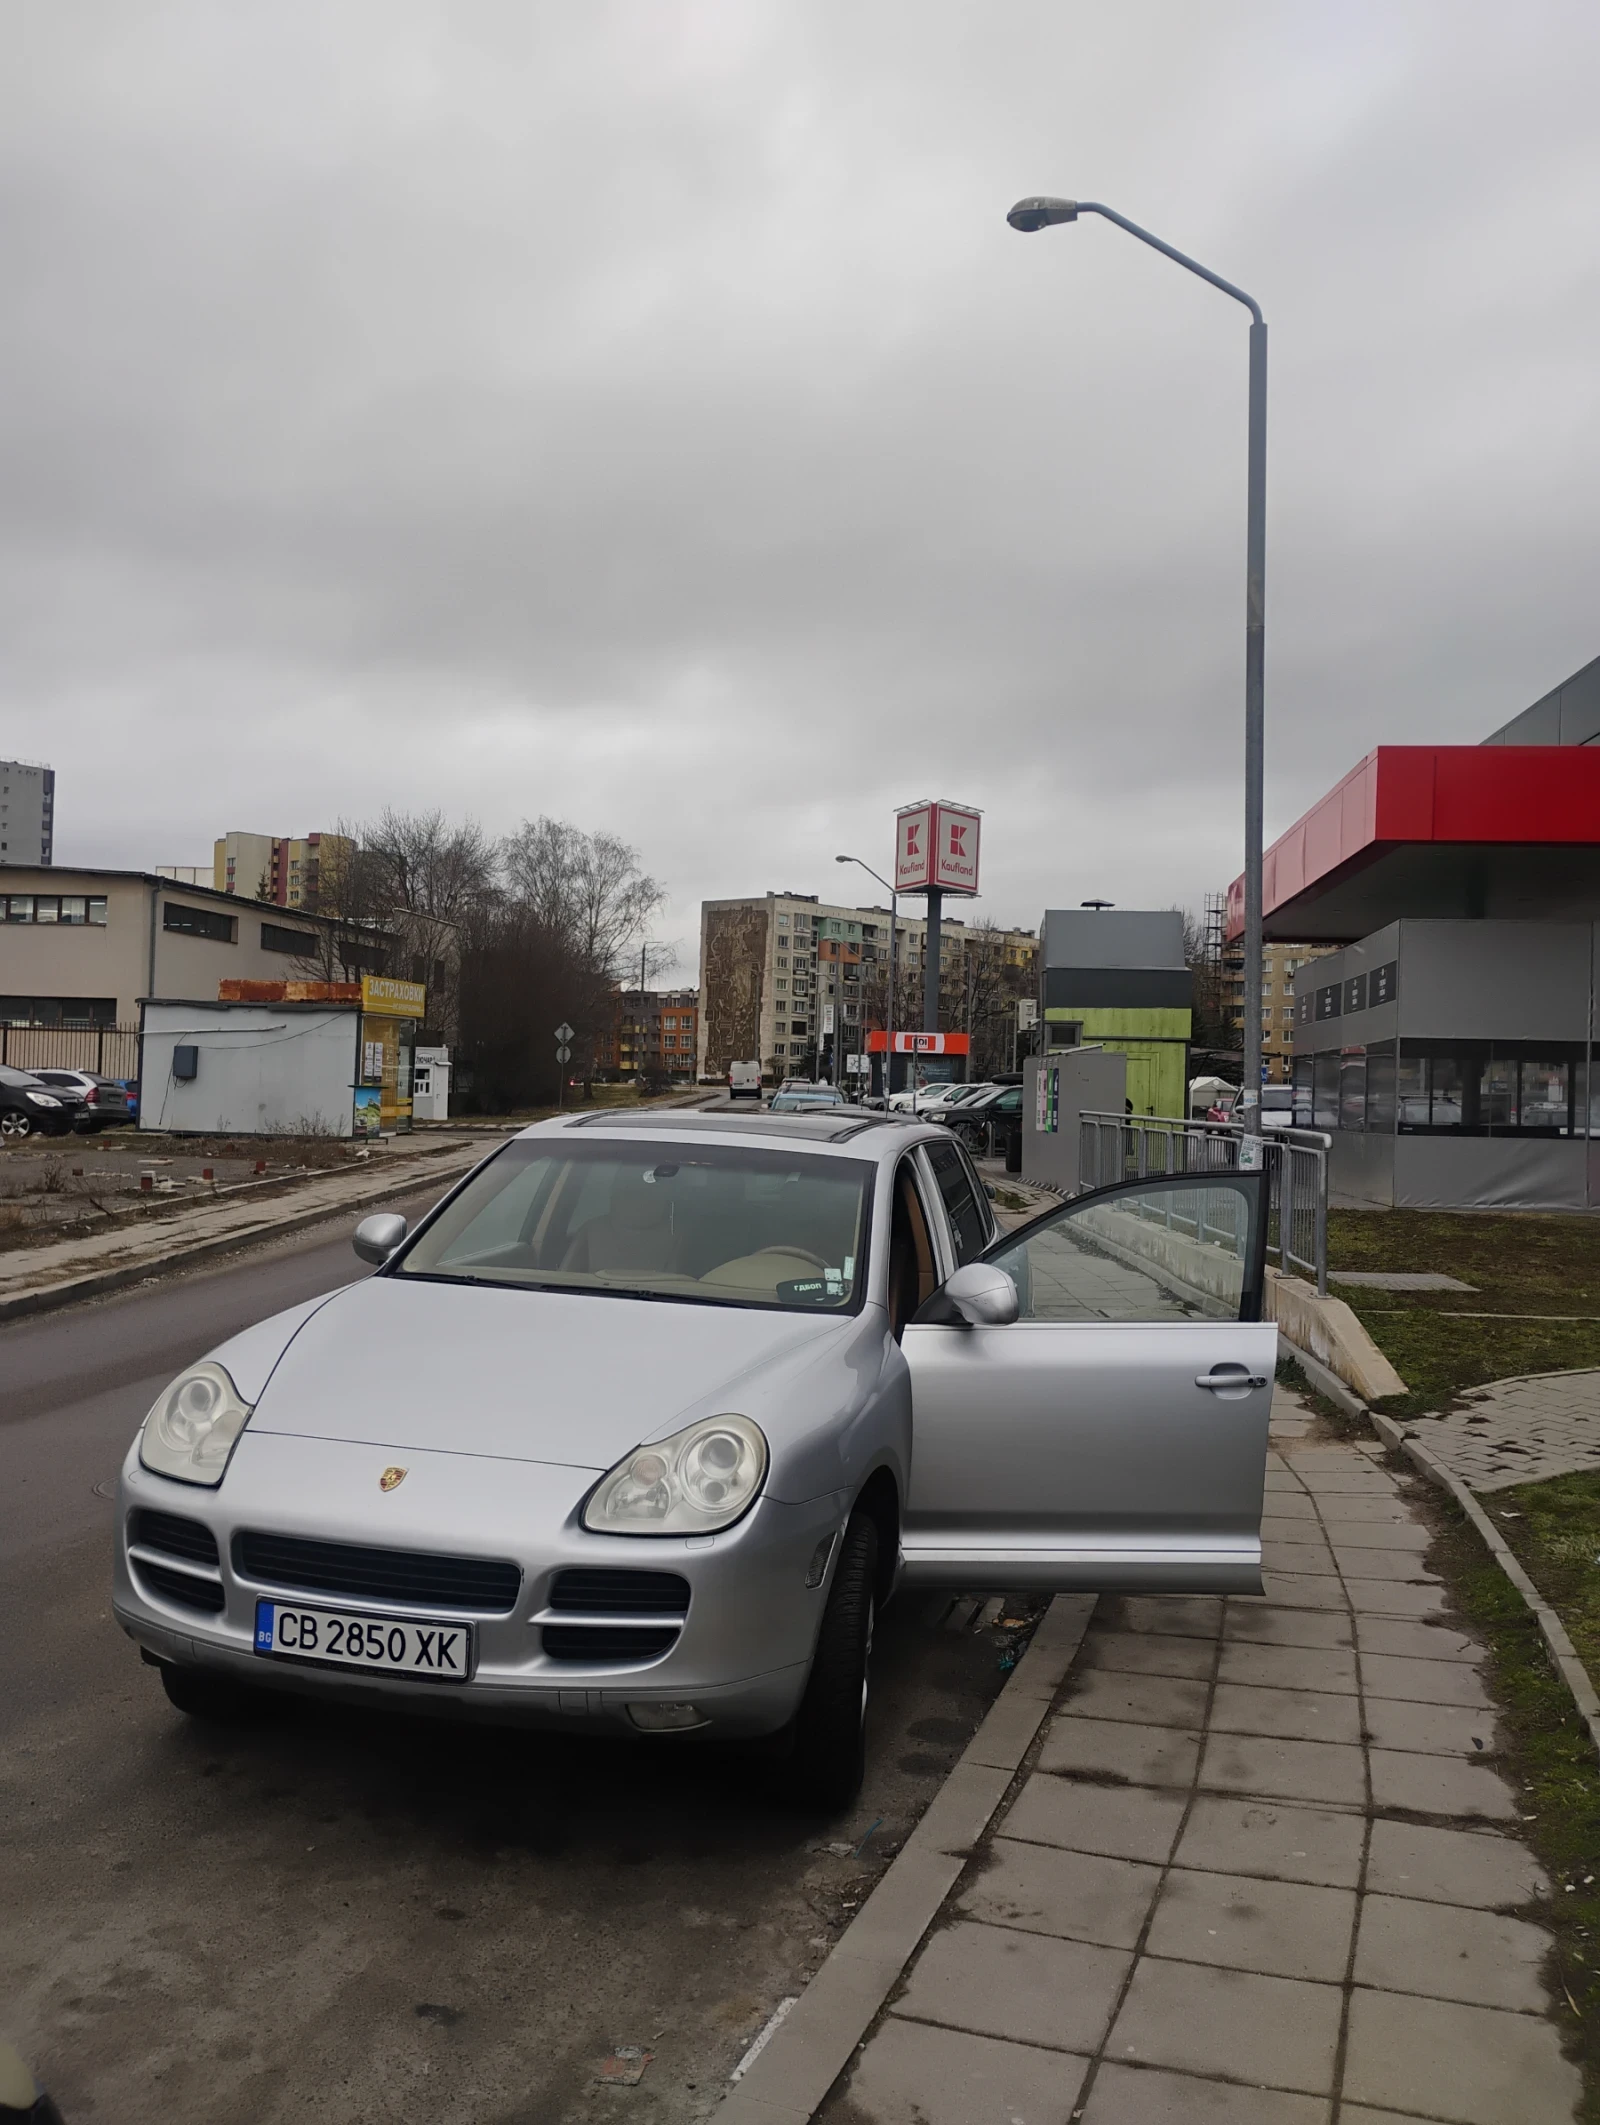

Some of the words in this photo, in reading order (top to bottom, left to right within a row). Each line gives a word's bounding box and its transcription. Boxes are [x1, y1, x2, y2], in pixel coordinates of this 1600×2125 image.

[899, 860, 925, 875] Kaufland
[941, 859, 974, 876] Kaufland
[368, 979, 424, 1003] ЗАСТРАХОВКИ
[258, 1631, 272, 1643] BG
[278, 1612, 319, 1650] CB
[325, 1619, 406, 1662] 2850
[415, 1629, 459, 1669] XK
